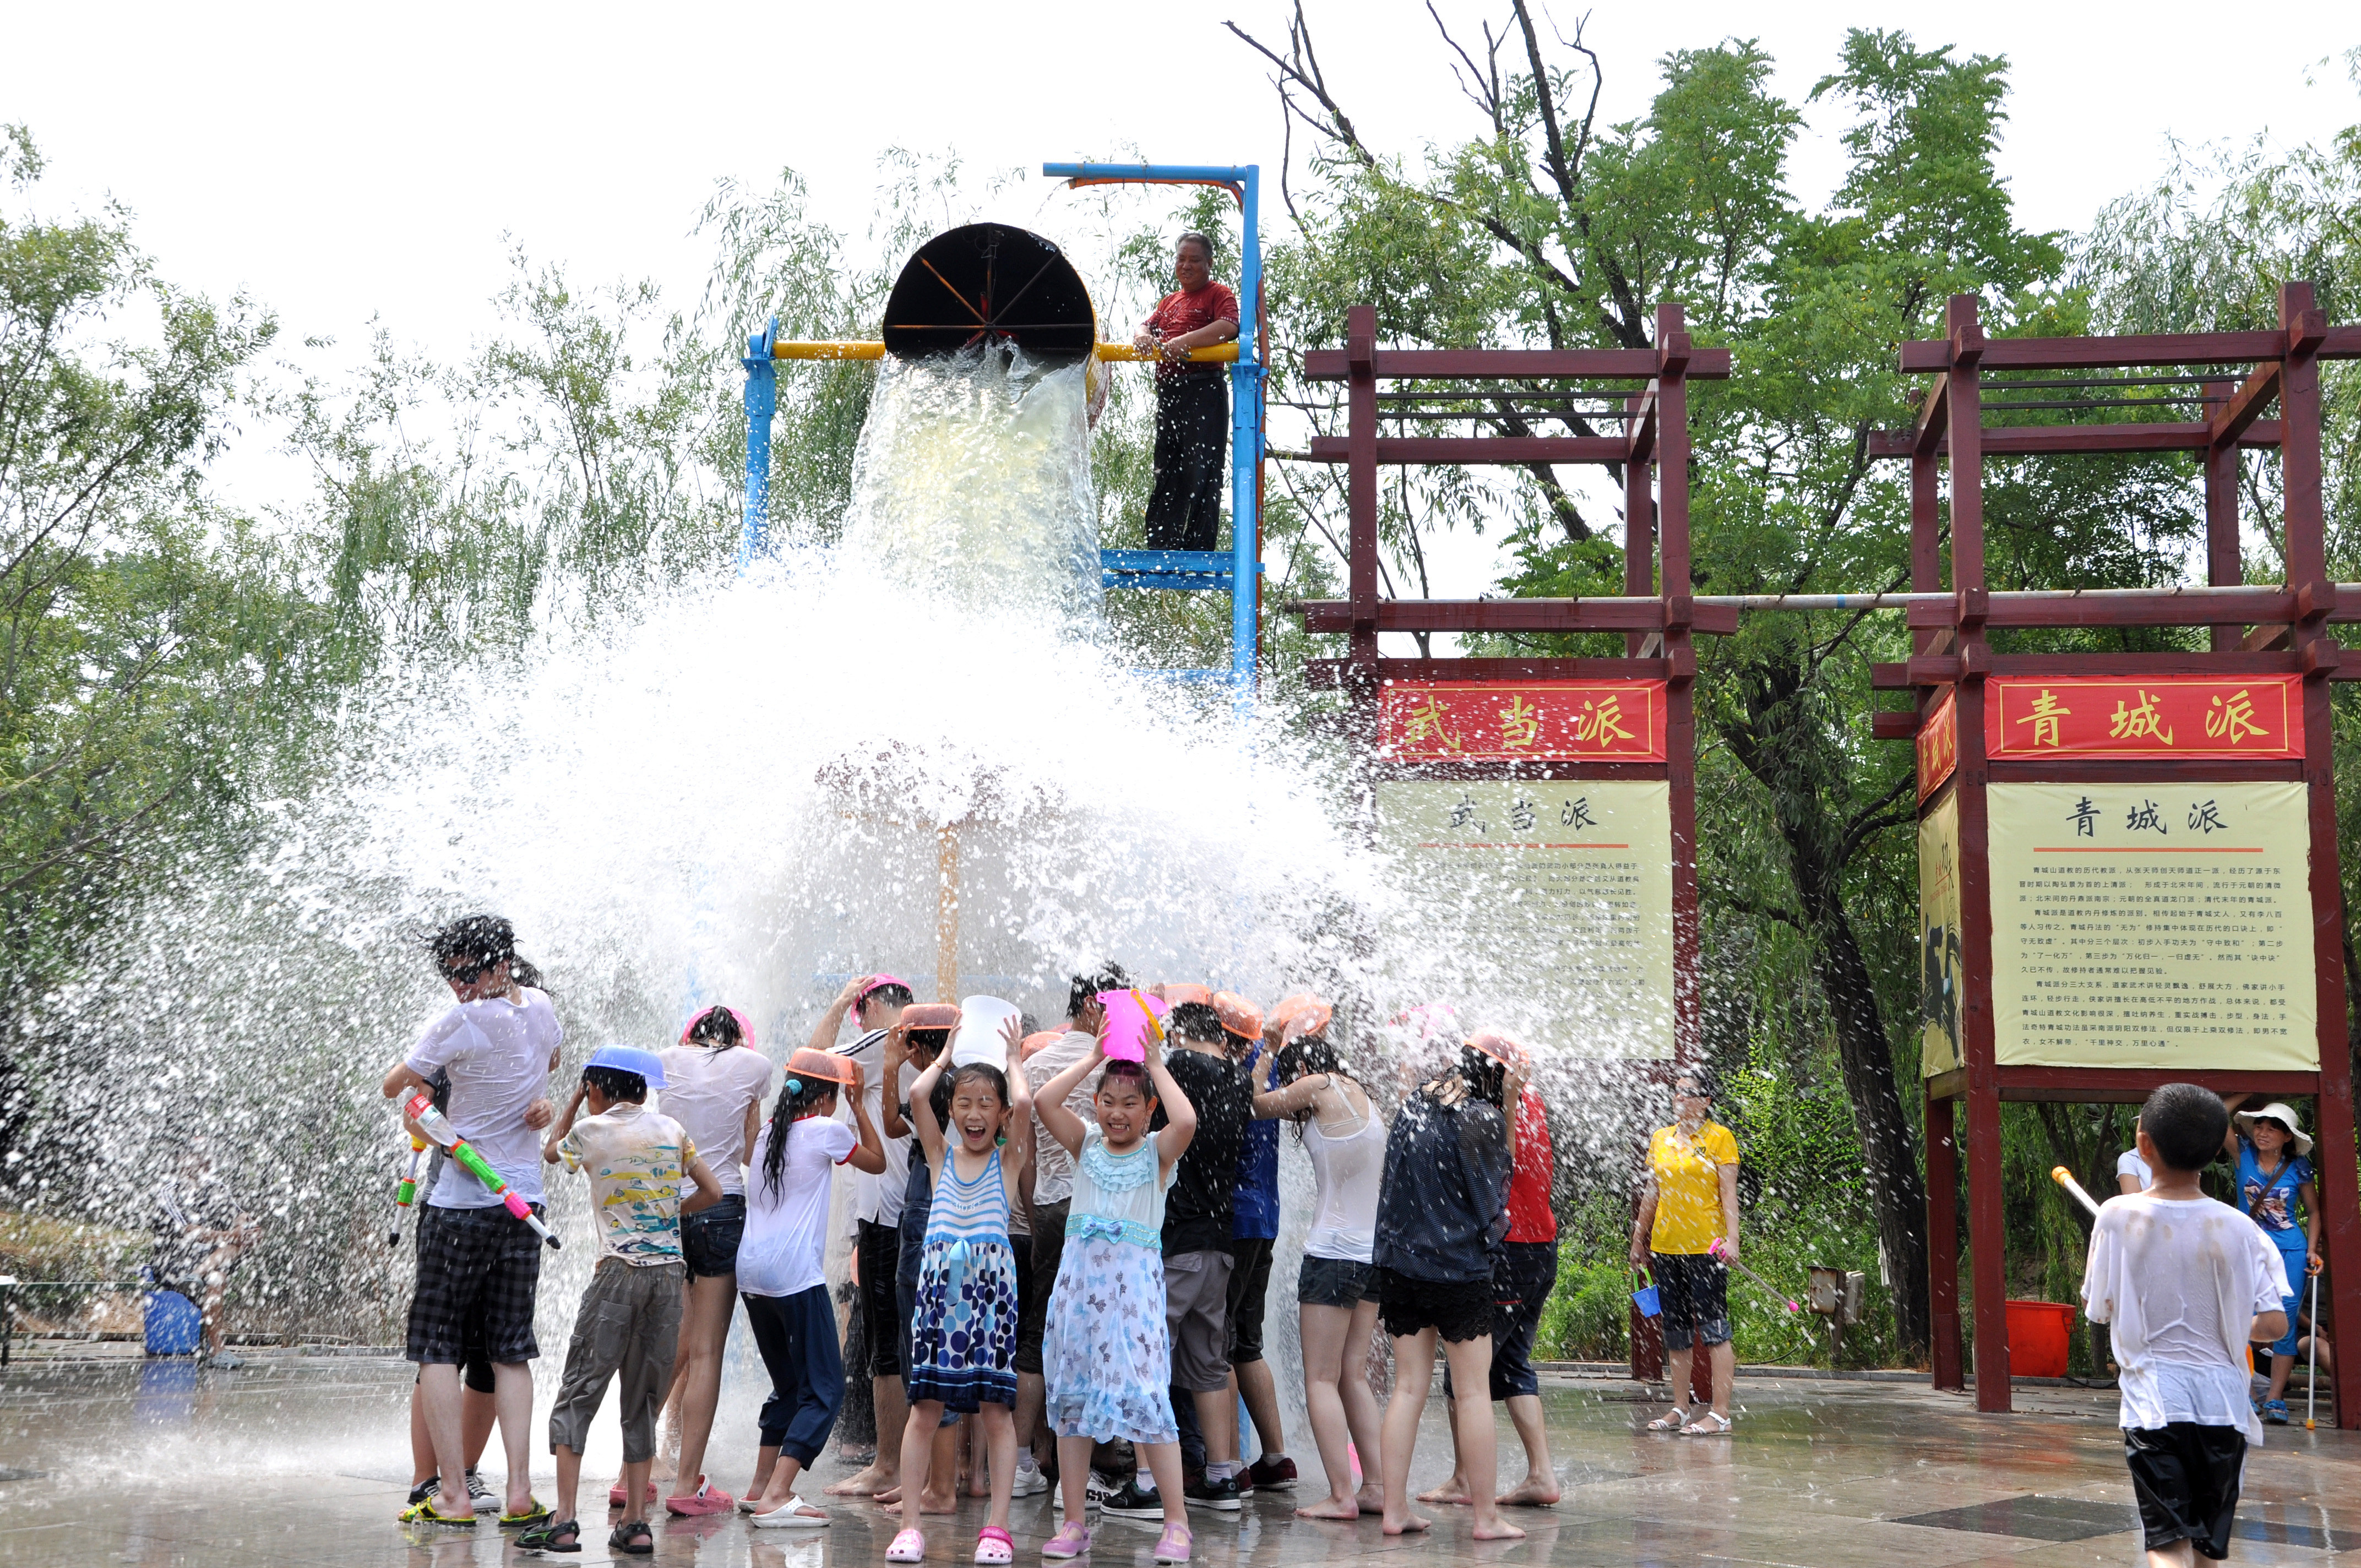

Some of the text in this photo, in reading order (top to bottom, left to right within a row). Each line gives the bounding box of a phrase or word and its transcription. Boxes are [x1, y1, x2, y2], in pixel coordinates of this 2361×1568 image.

[1405, 695, 1635, 749] 武当派
[2016, 689, 2270, 746] 青城派
[1449, 794, 1598, 833] 武当派
[2066, 796, 2228, 837] 青城派
